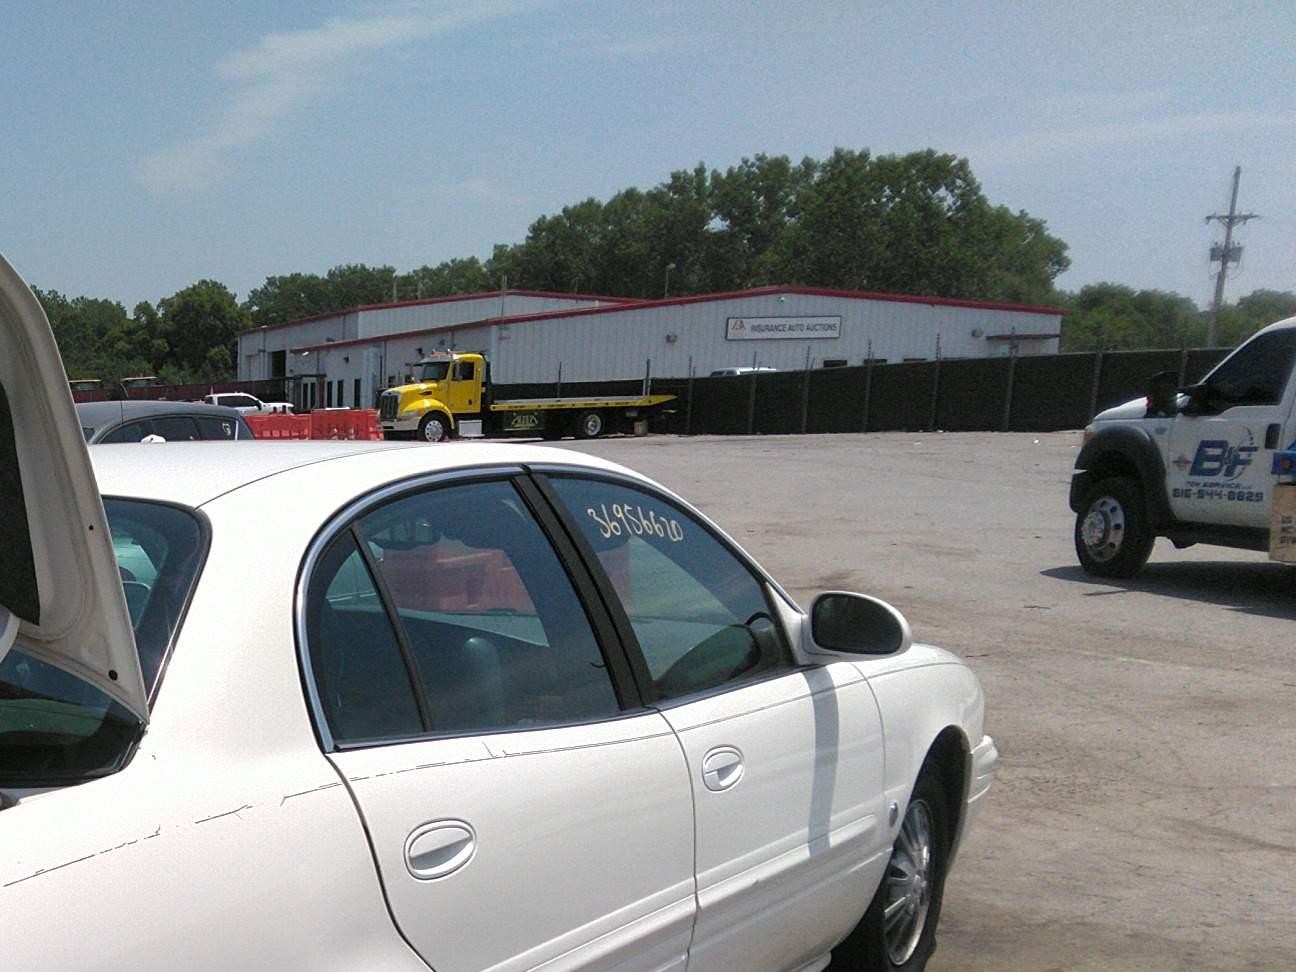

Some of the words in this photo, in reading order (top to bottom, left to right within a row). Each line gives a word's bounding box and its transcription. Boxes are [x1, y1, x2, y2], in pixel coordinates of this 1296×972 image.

[751, 324, 786, 332] INSURANCE
[787, 323, 805, 332] AUTO
[806, 322, 837, 332] AUCTIONS
[586, 503, 684, 542] 36956620
